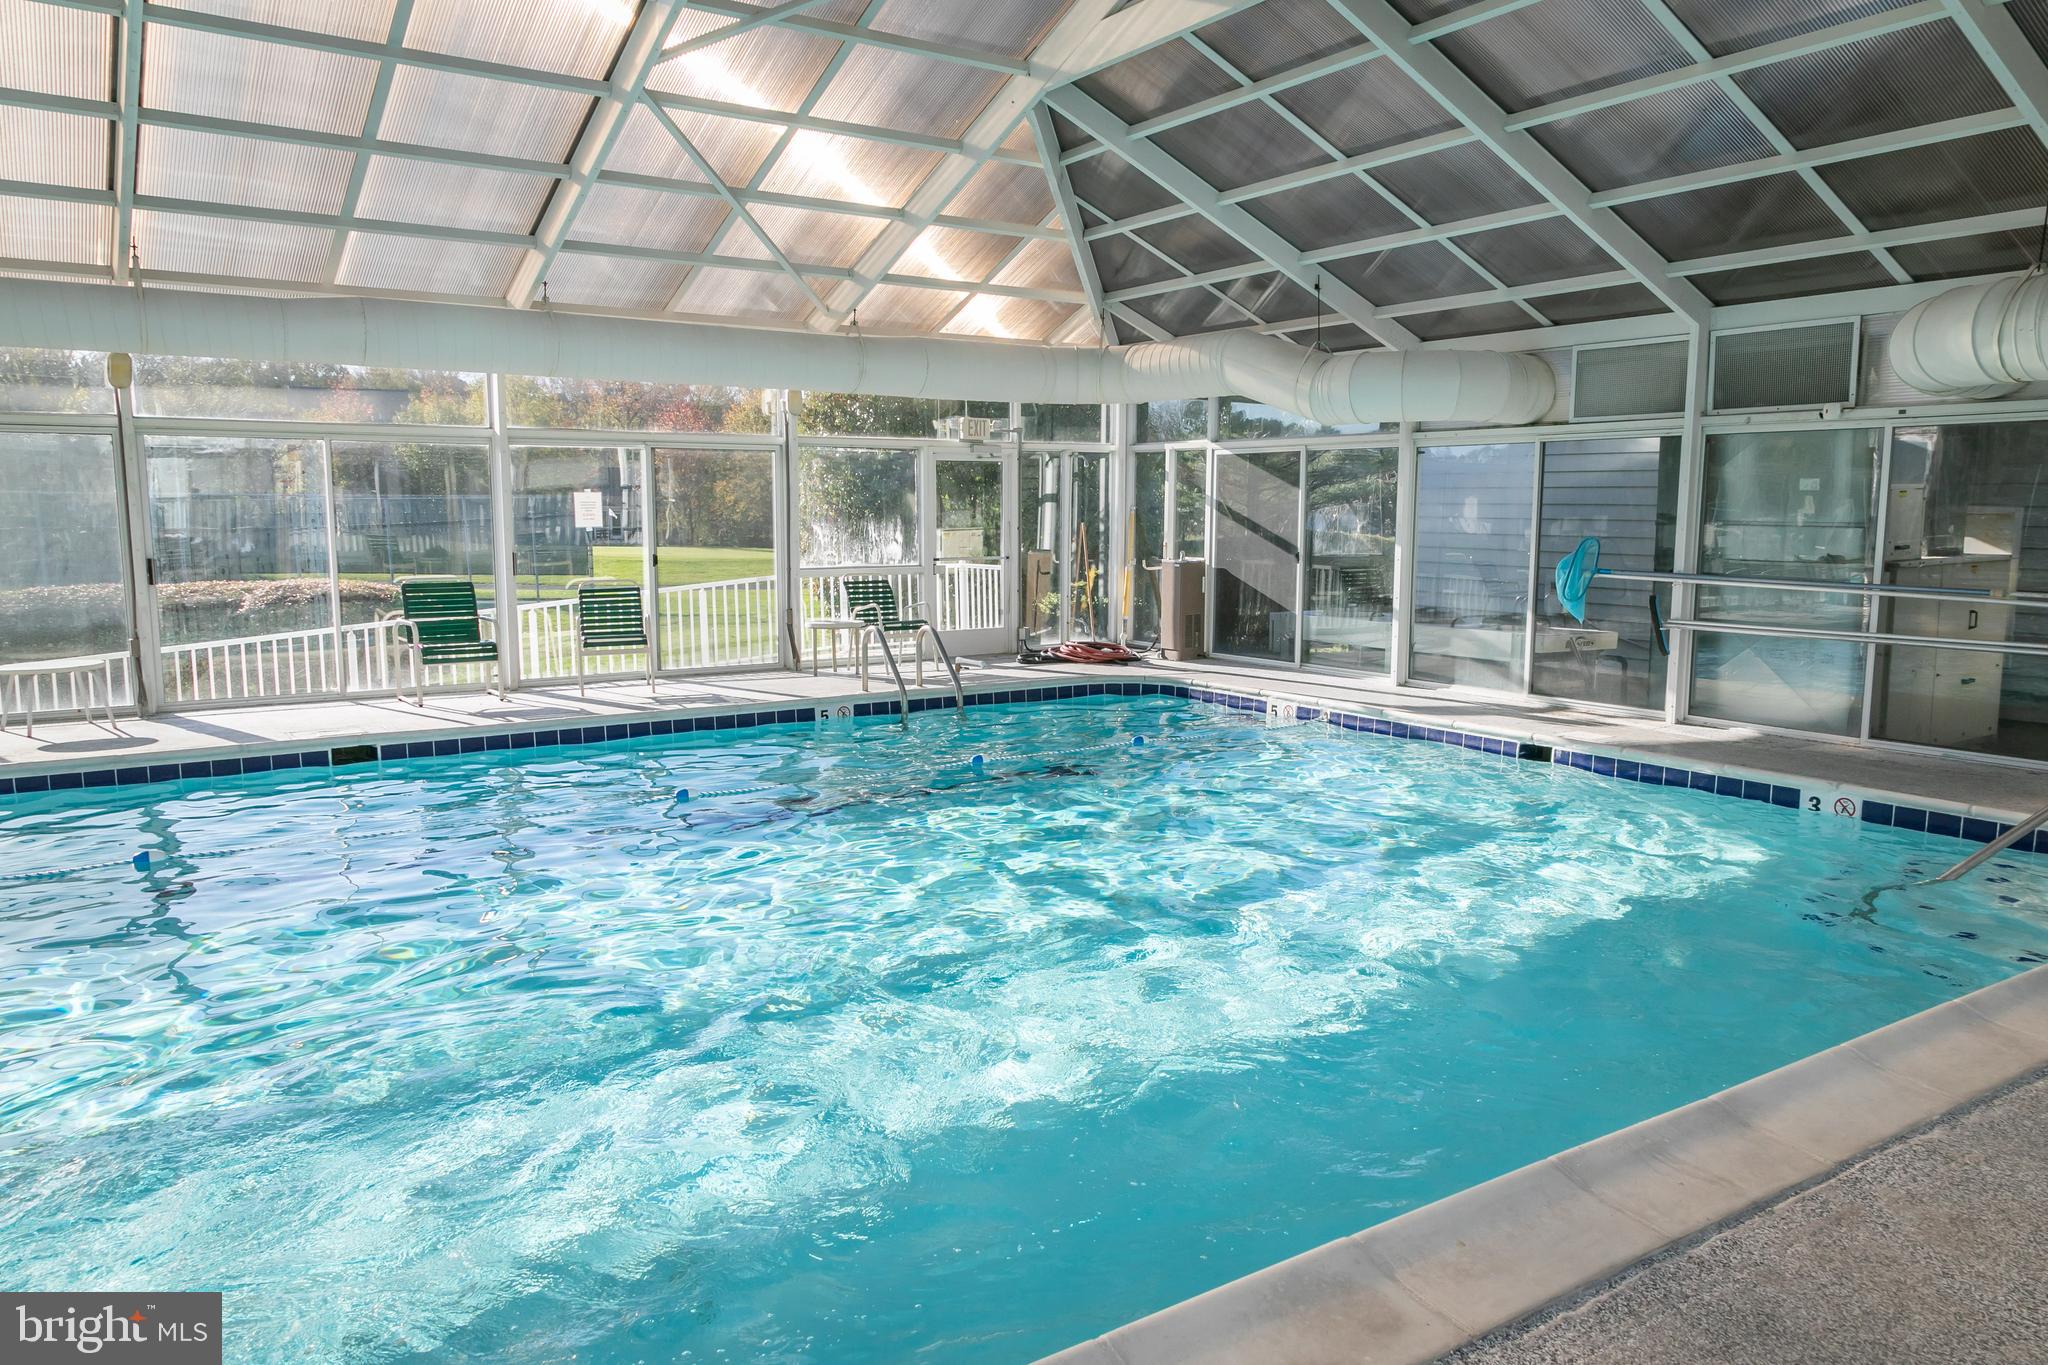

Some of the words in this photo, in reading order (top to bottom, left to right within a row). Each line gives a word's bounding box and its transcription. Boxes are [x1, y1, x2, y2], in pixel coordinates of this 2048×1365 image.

[968, 418, 987, 437] EXIT
[820, 709, 829, 720] 5
[1271, 704, 1278, 717] 5
[1807, 796, 1821, 811] 3
